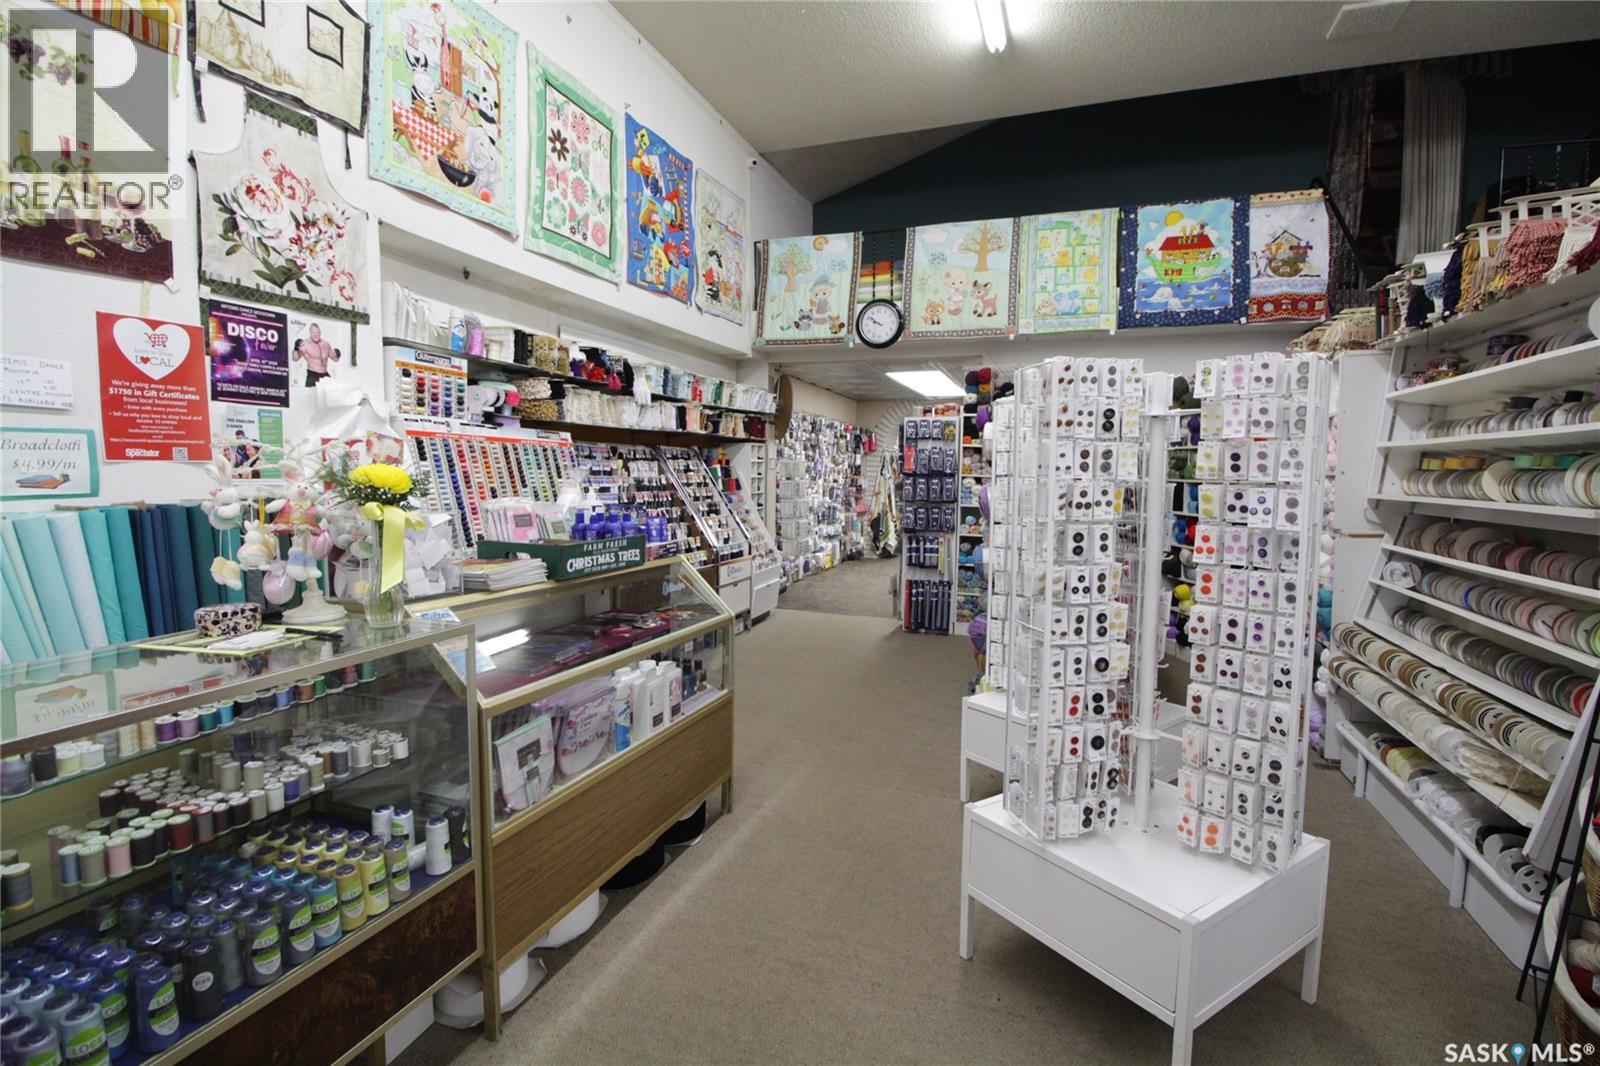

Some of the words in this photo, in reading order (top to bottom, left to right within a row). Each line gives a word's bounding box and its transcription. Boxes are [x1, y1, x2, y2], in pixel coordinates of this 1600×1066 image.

[227, 322, 279, 343] DISCO
[131, 381, 150, 389] giving
[150, 382, 166, 391] away
[108, 387, 132, 396] $1750
[134, 388, 142, 396] in
[143, 389, 158, 398] Gift
[158, 390, 200, 400] Certificates
[1, 438, 82, 452] Broadcloth
[125, 448, 160, 458] Spectator
[12, 459, 77, 472] $4.99/m
[584, 542, 604, 552] FARM
[606, 539, 628, 548] FRESH
[566, 552, 616, 573] CHRISTMAS
[618, 548, 640, 562] TREES
